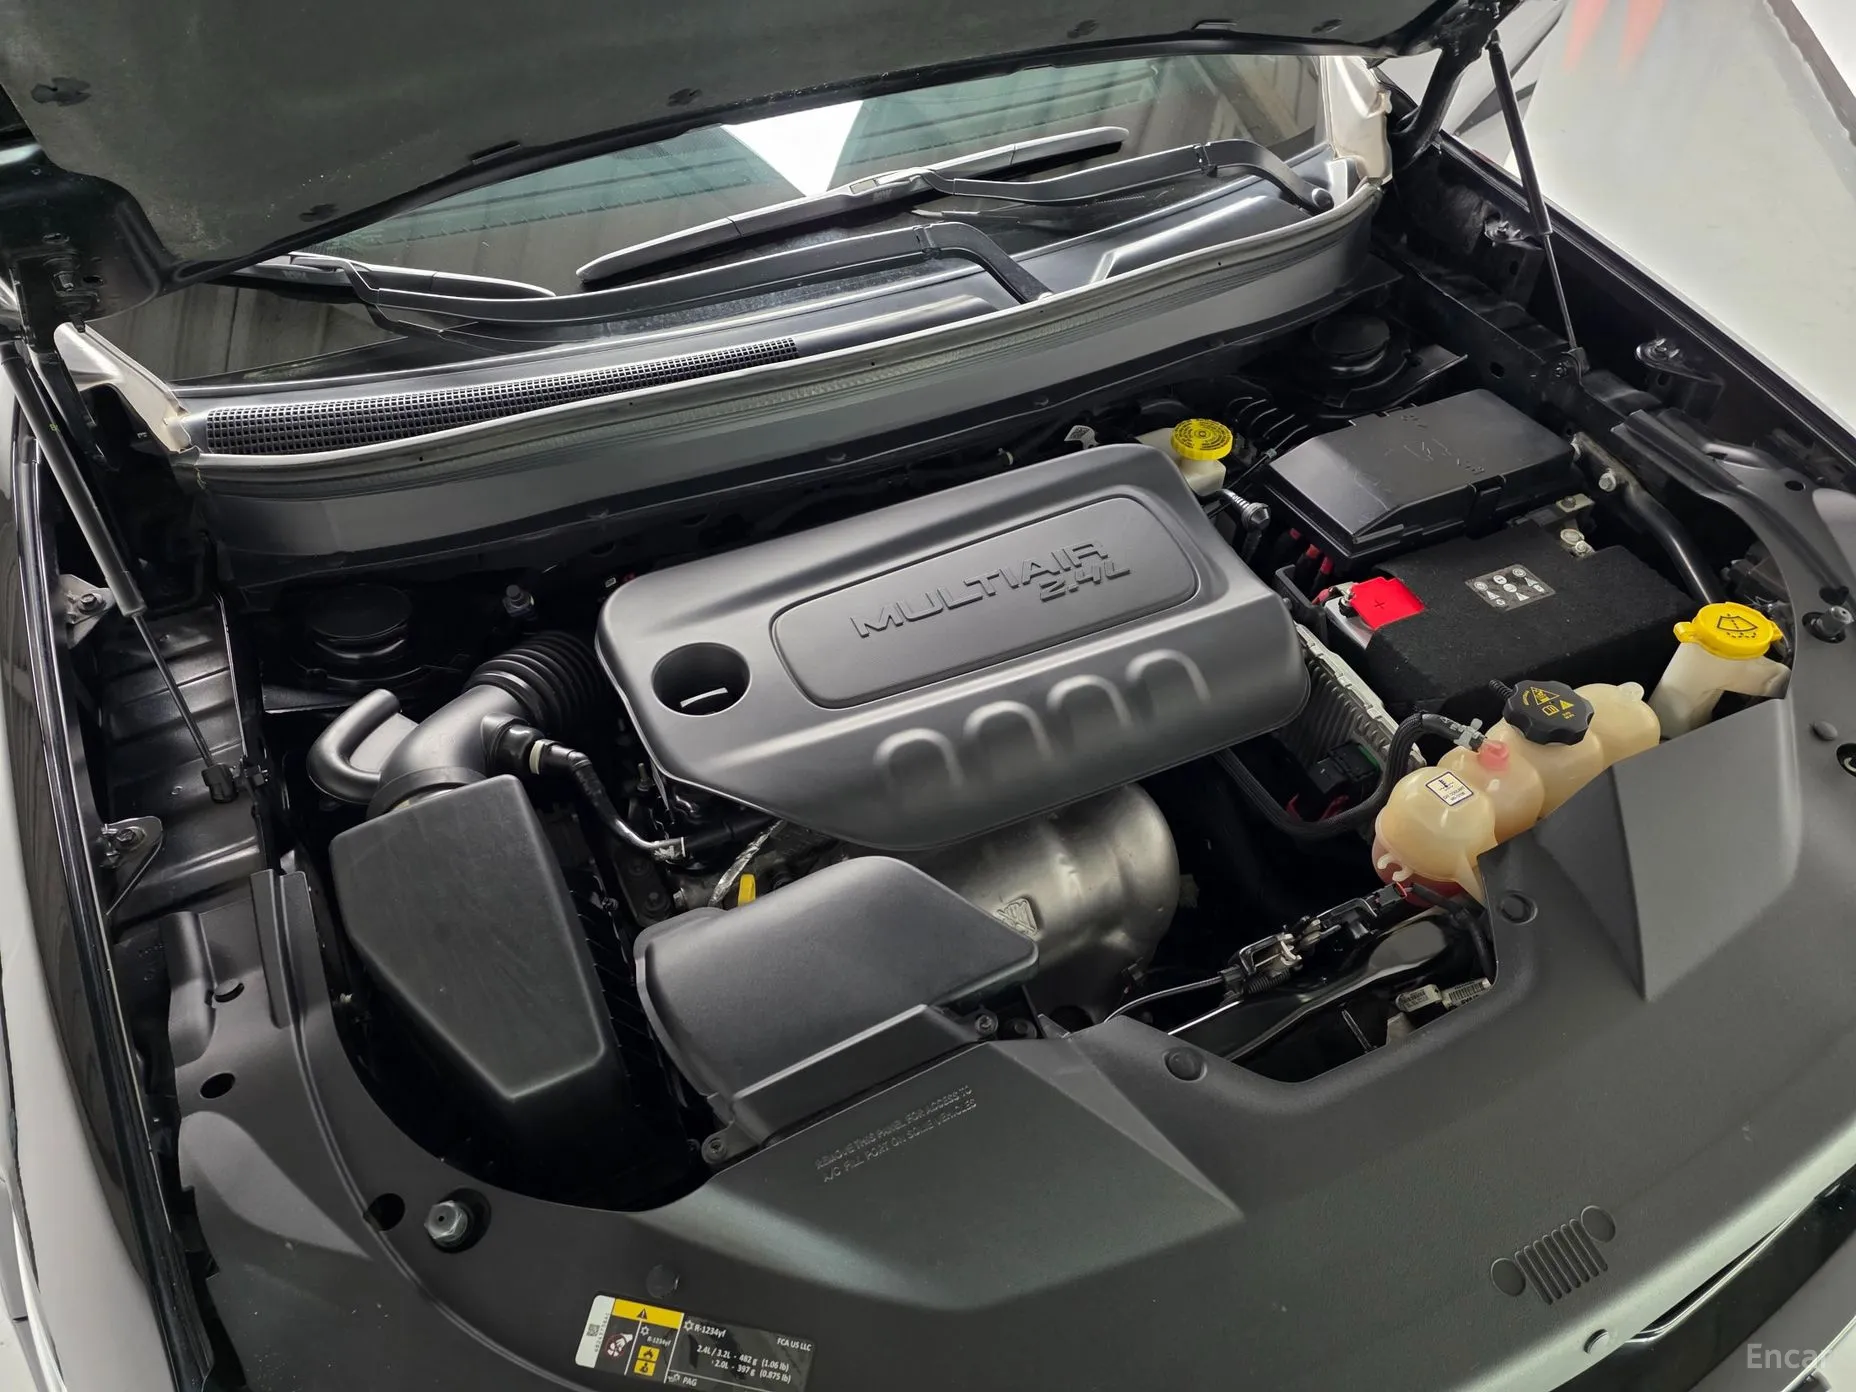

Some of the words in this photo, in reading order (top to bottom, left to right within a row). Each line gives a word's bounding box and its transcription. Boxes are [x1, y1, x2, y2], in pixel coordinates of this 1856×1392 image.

[849, 539, 1109, 638] MULTIAIR
[1038, 556, 1131, 602] 2.4L
[854, 1132, 877, 1150] THIS
[905, 1109, 925, 1124] FOR
[926, 1092, 960, 1114] ACCESS
[959, 1084, 973, 1099] TO
[824, 1166, 841, 1183] A/C
[866, 1142, 890, 1161] PORT
[693, 1323, 727, 1339] R-1234yf
[777, 1337, 790, 1347] FCA
[790, 1340, 800, 1349] US
[800, 1341, 812, 1351] LLC
[696, 1344, 711, 1355] 2.4L
[716, 1349, 731, 1359] 3.2L
[739, 1354, 752, 1363] 482
[779, 1362, 790, 1372] lb)
[714, 1360, 729, 1369] 2.0L
[737, 1364, 750, 1374] 397
[781, 1374, 791, 1384] lb)
[682, 1377, 698, 1387] PAG
